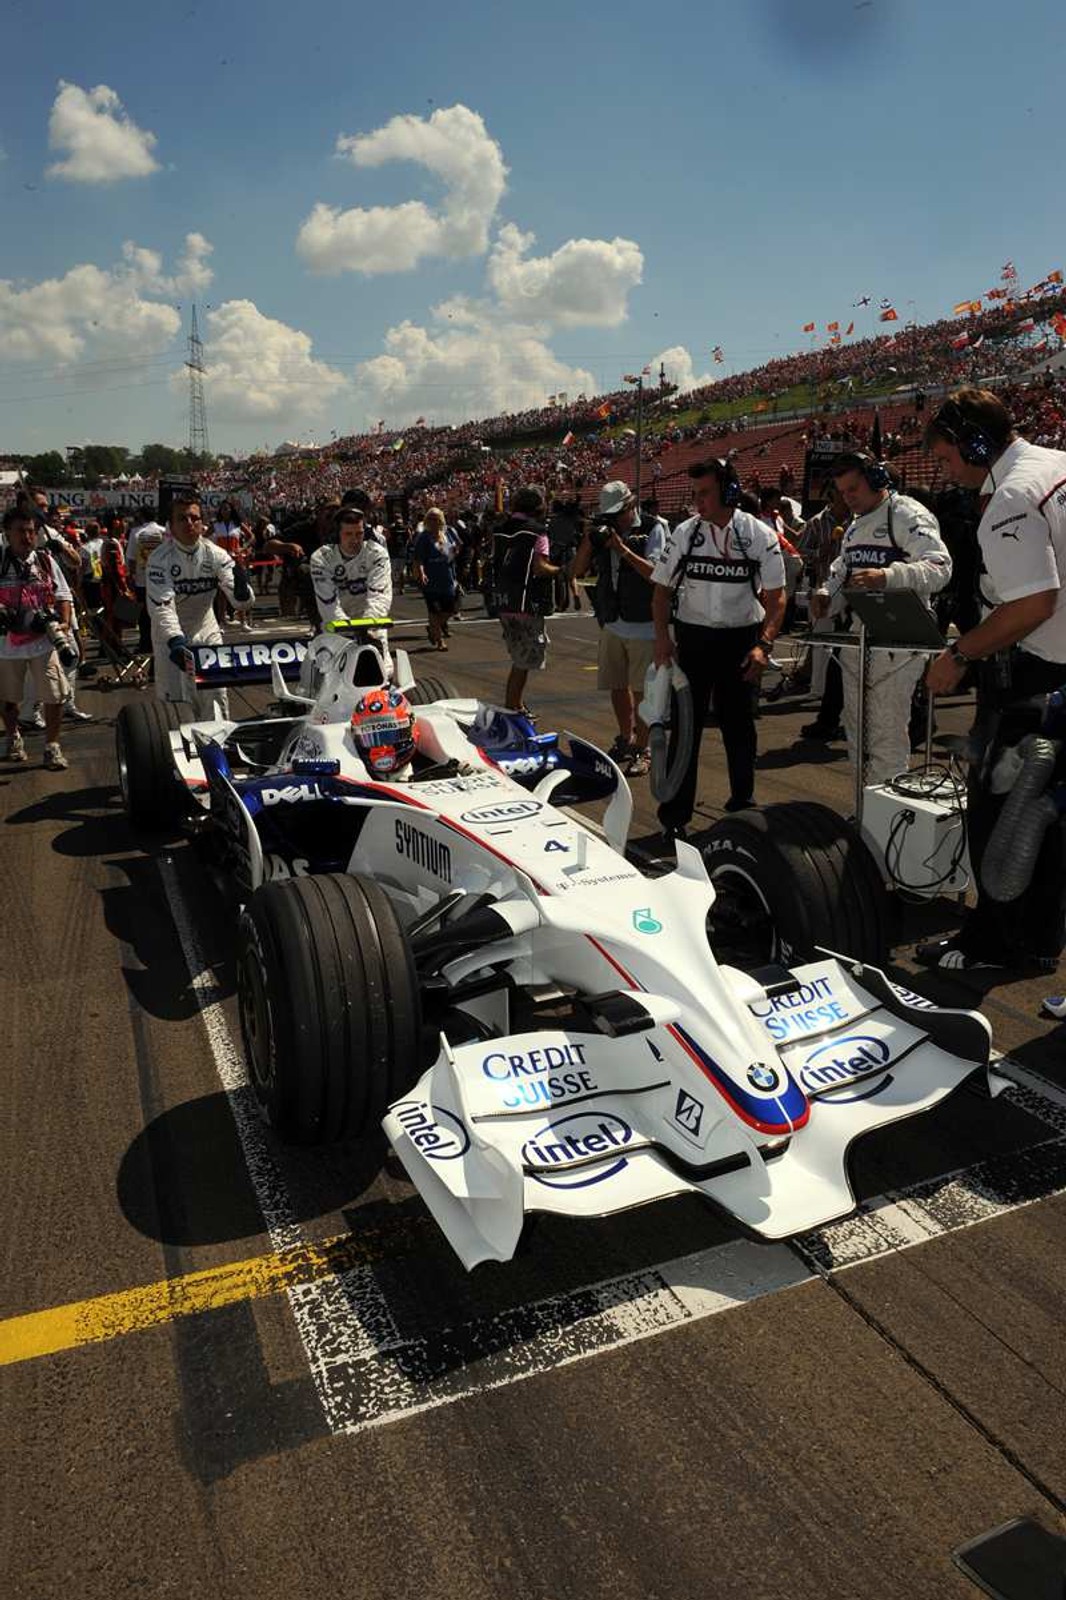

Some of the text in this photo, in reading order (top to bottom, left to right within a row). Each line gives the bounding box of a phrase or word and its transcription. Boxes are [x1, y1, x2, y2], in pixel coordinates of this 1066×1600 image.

[50, 493, 86, 507] ING
[121, 493, 155, 507] ING
[200, 494, 221, 508] NG
[686, 562, 749, 577] PETRONAS
[261, 783, 323, 806] DELL
[468, 803, 531, 821] intel
[395, 819, 452, 884] SYNTIUM
[544, 839, 570, 853] 4
[748, 977, 833, 1017] CREDIT
[764, 1001, 849, 1040] SUISSE
[483, 1044, 588, 1081] CREDIT
[803, 1045, 882, 1085] intel
[503, 1071, 598, 1107] SUISSE
[398, 1103, 457, 1156] intel
[528, 1124, 622, 1163] intel
